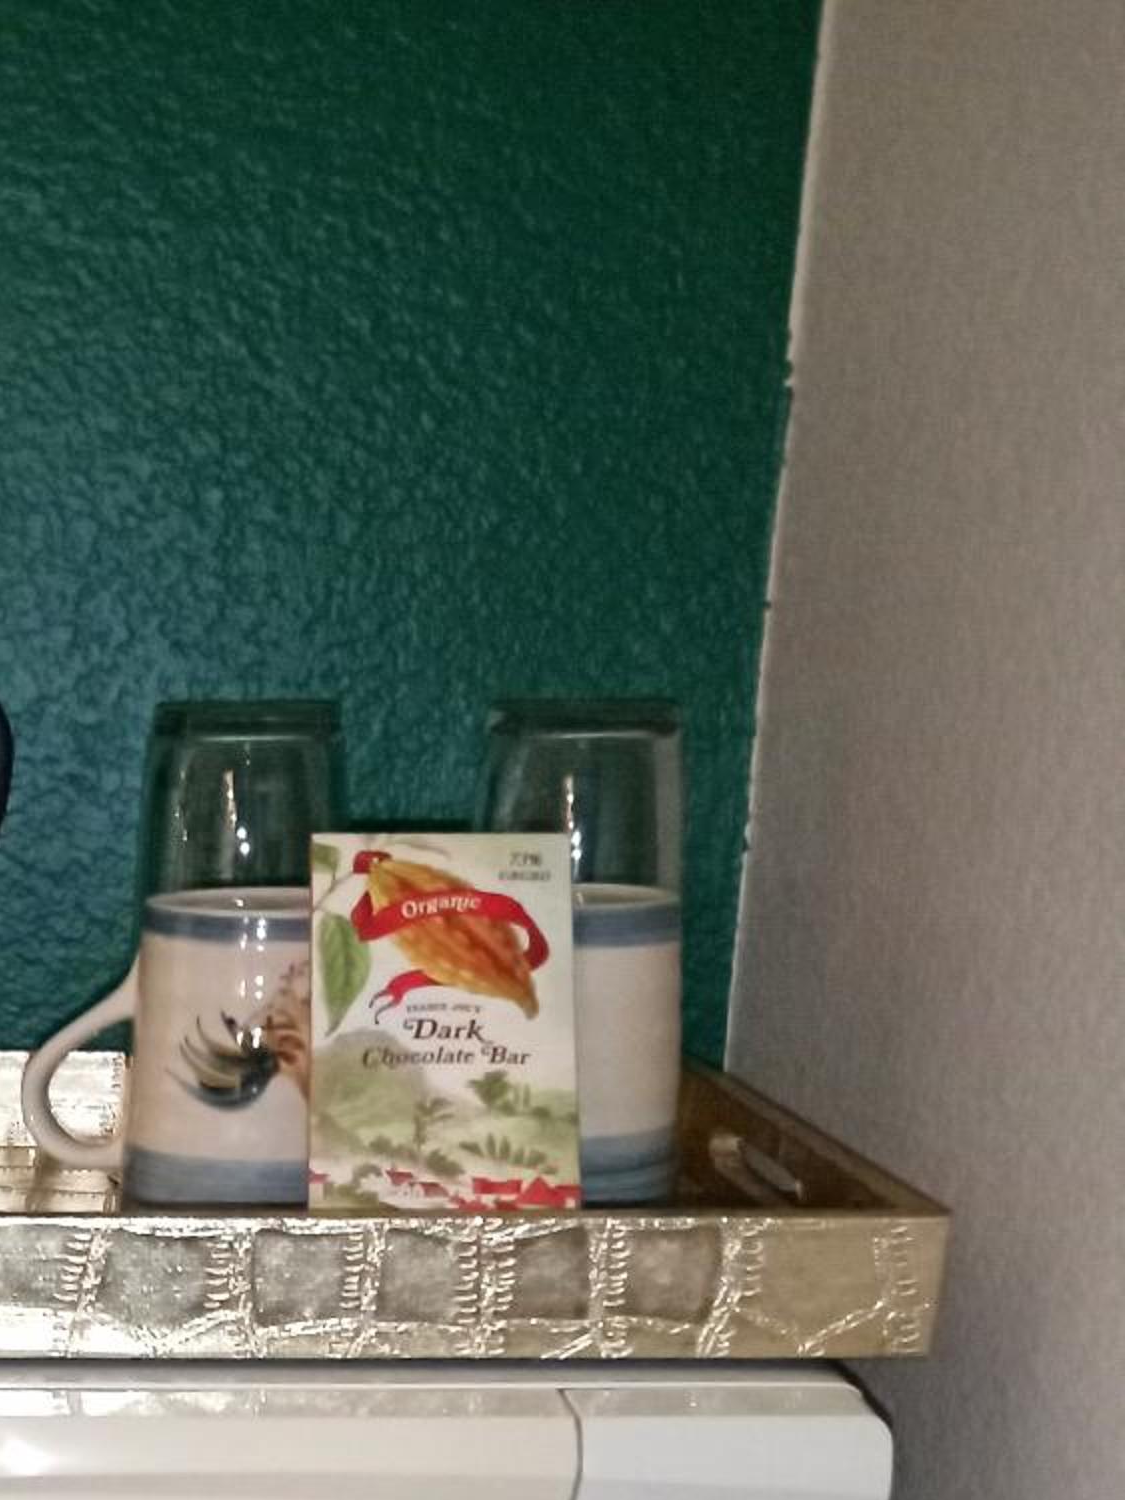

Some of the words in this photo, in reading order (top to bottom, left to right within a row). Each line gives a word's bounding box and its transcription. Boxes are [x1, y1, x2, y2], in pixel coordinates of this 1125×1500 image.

[401, 896, 482, 919] Organic
[403, 1019, 487, 1043] Dark
[362, 1045, 475, 1068] Chocolate
[481, 1045, 531, 1066] Bar
